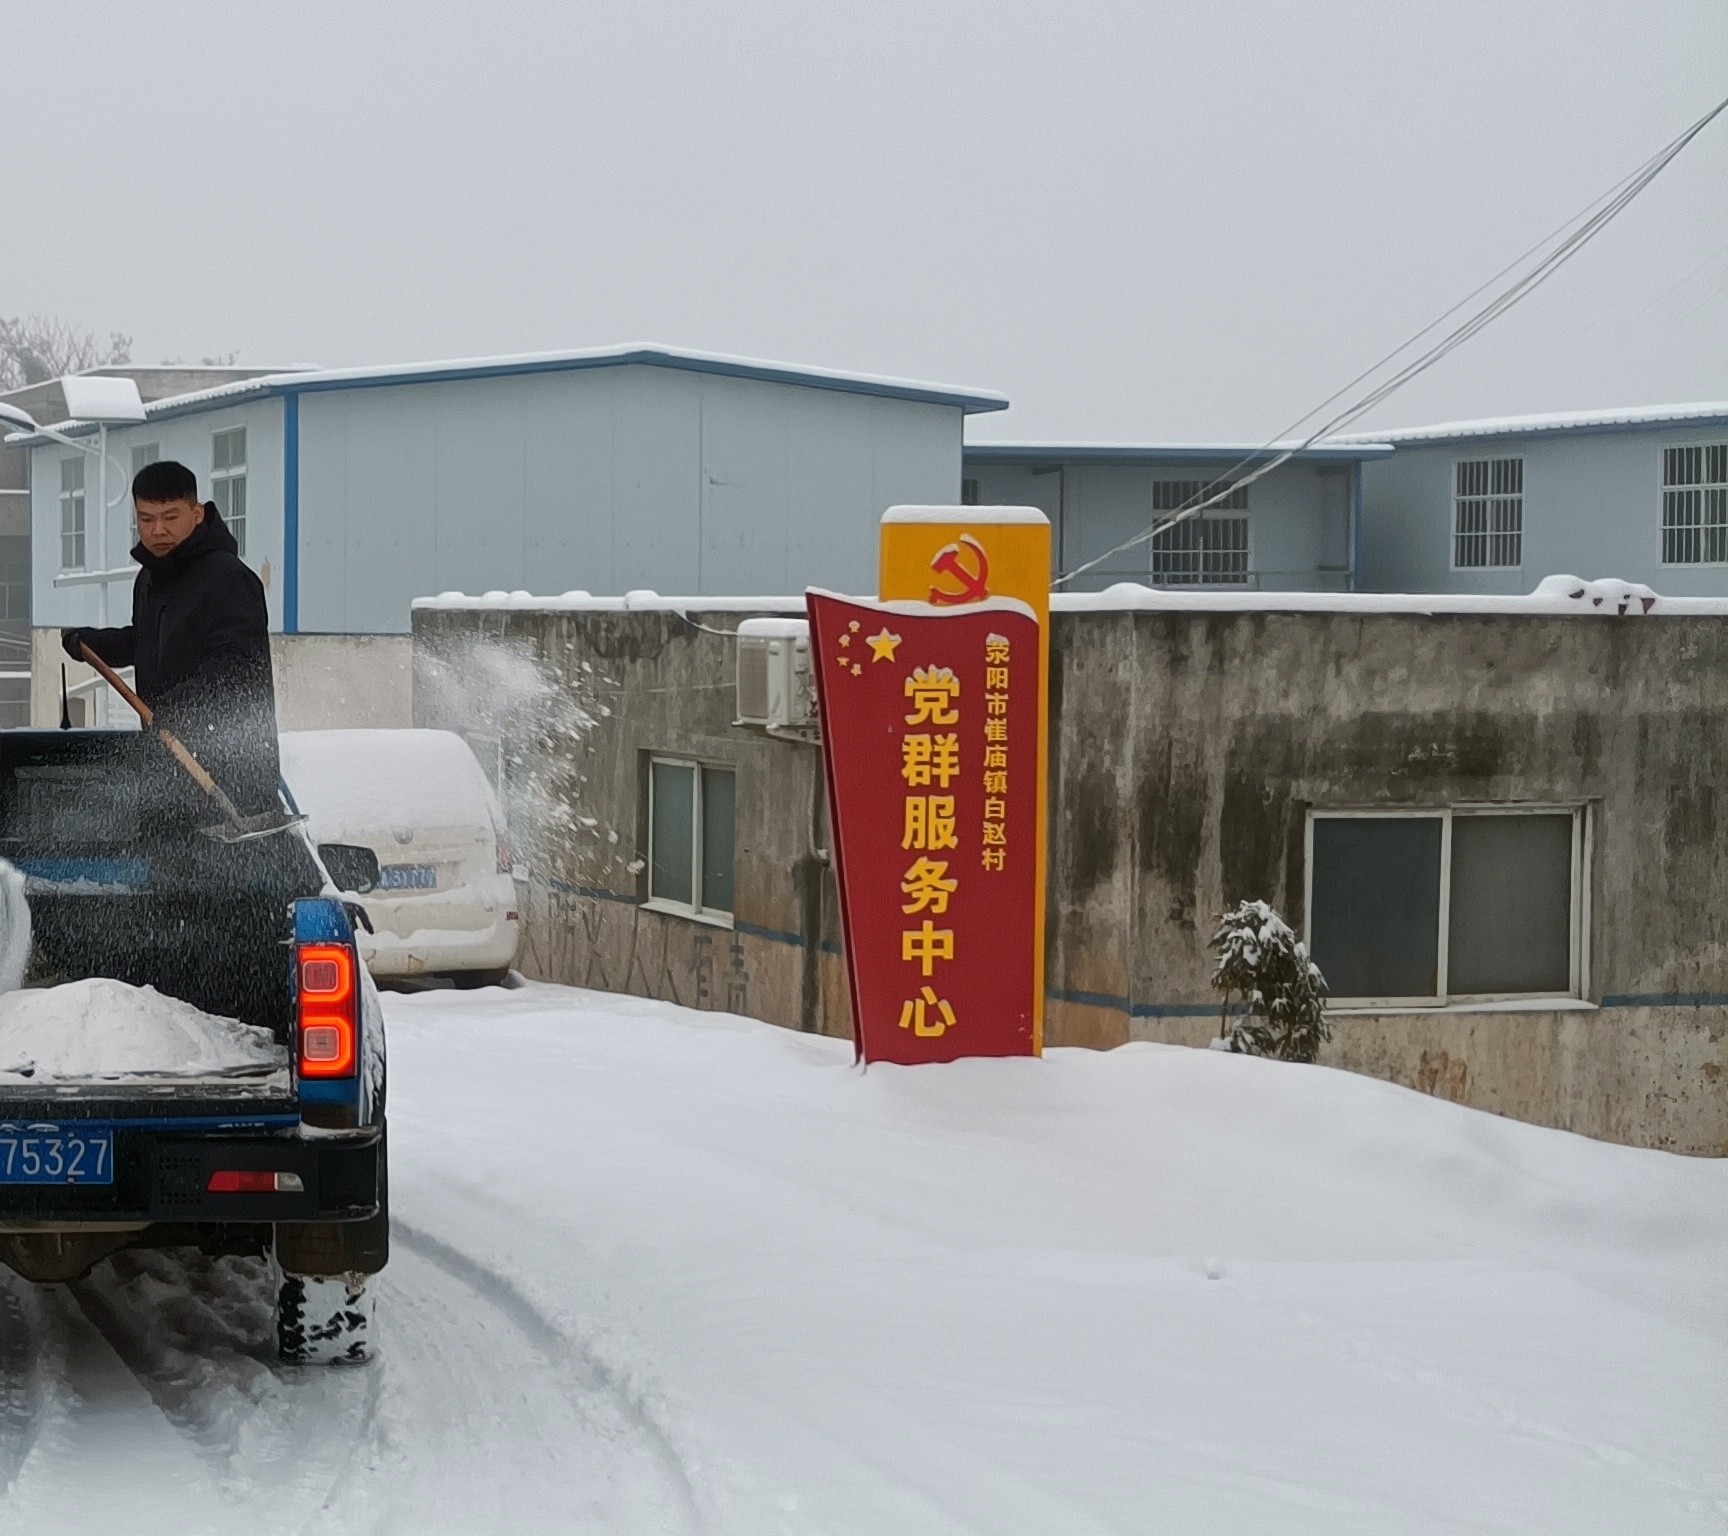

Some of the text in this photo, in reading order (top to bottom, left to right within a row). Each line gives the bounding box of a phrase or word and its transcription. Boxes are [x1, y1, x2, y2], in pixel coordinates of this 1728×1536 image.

[898, 665, 960, 1038] 党群服务中心
[981, 633, 1010, 871] 荥阳市崔庙镇白赵村
